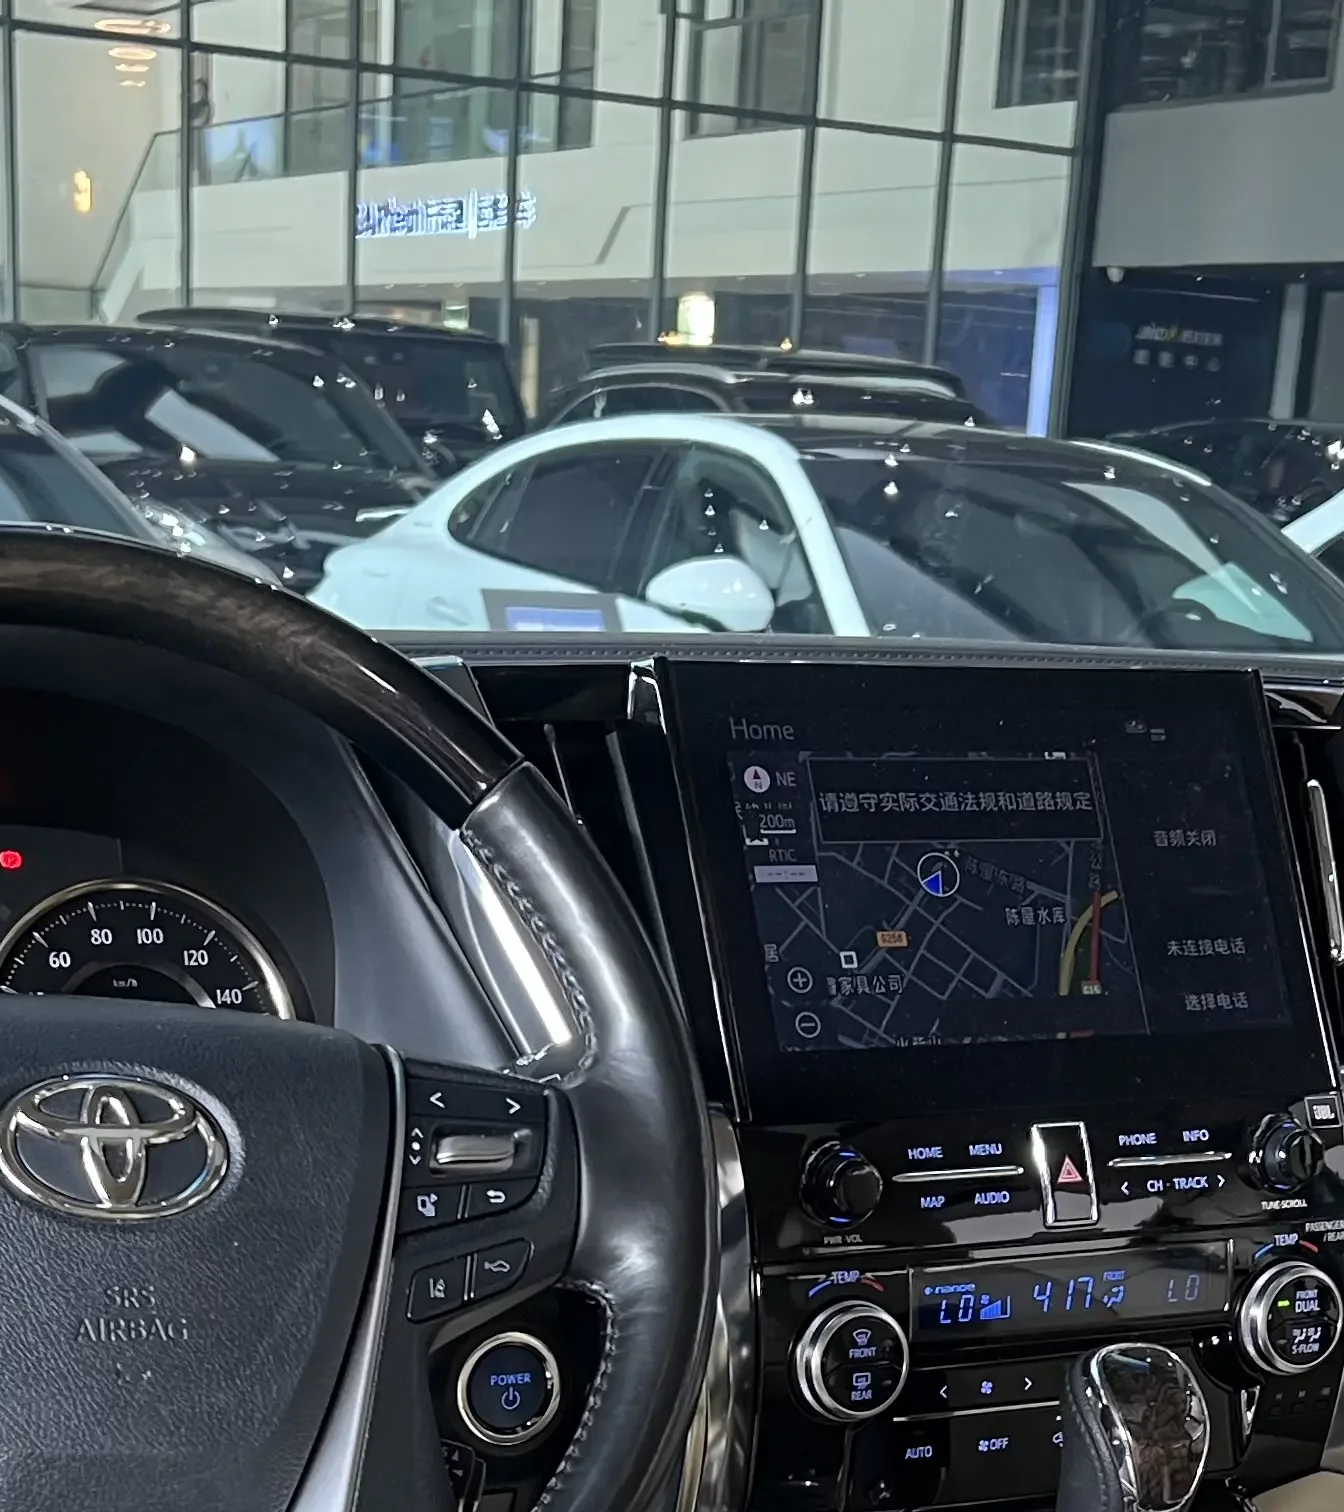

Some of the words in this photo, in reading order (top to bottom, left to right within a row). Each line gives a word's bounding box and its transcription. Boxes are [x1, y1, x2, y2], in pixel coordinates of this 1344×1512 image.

[728, 717, 795, 740] Home
[775, 771, 797, 787] NE
[818, 791, 1093, 813] 请遵守实际交通法规和道路规定
[1153, 829, 1217, 848] 音频关闭
[90, 928, 113, 945] 80
[136, 928, 164, 944] 100
[1167, 937, 1246, 956] 未连接电话
[48, 951, 71, 968] 60
[183, 949, 209, 966] 120
[112, 978, 138, 988] km/h
[215, 989, 243, 1005] 140
[1184, 991, 1249, 1011] 选择电话
[1312, 1104, 1335, 1120] JBL
[1118, 1132, 1157, 1146] PHONE
[1182, 1129, 1209, 1142] INFO
[908, 1146, 943, 1160] HOME
[968, 1143, 1003, 1156] MENU
[1146, 1179, 1164, 1192] CH
[1172, 1175, 1209, 1190] TRACK
[920, 1195, 945, 1209] MAP
[974, 1190, 1010, 1205] AUDIO
[1305, 1220, 1344, 1233] PASSENGER
[1274, 1232, 1298, 1246] TEMP
[831, 1270, 860, 1284] TEMP
[106, 1285, 156, 1308] SRS
[1296, 1289, 1318, 1300] FRONT
[1295, 1299, 1320, 1313] DUAL
[76, 1317, 189, 1342] AIRBAG
[848, 1346, 877, 1359] FRONT
[1291, 1342, 1320, 1354] S-FLOW
[490, 1372, 531, 1386] POWER
[851, 1389, 873, 1401] REAR
[989, 1437, 1009, 1450] OFF
[905, 1445, 933, 1460] AUTO
